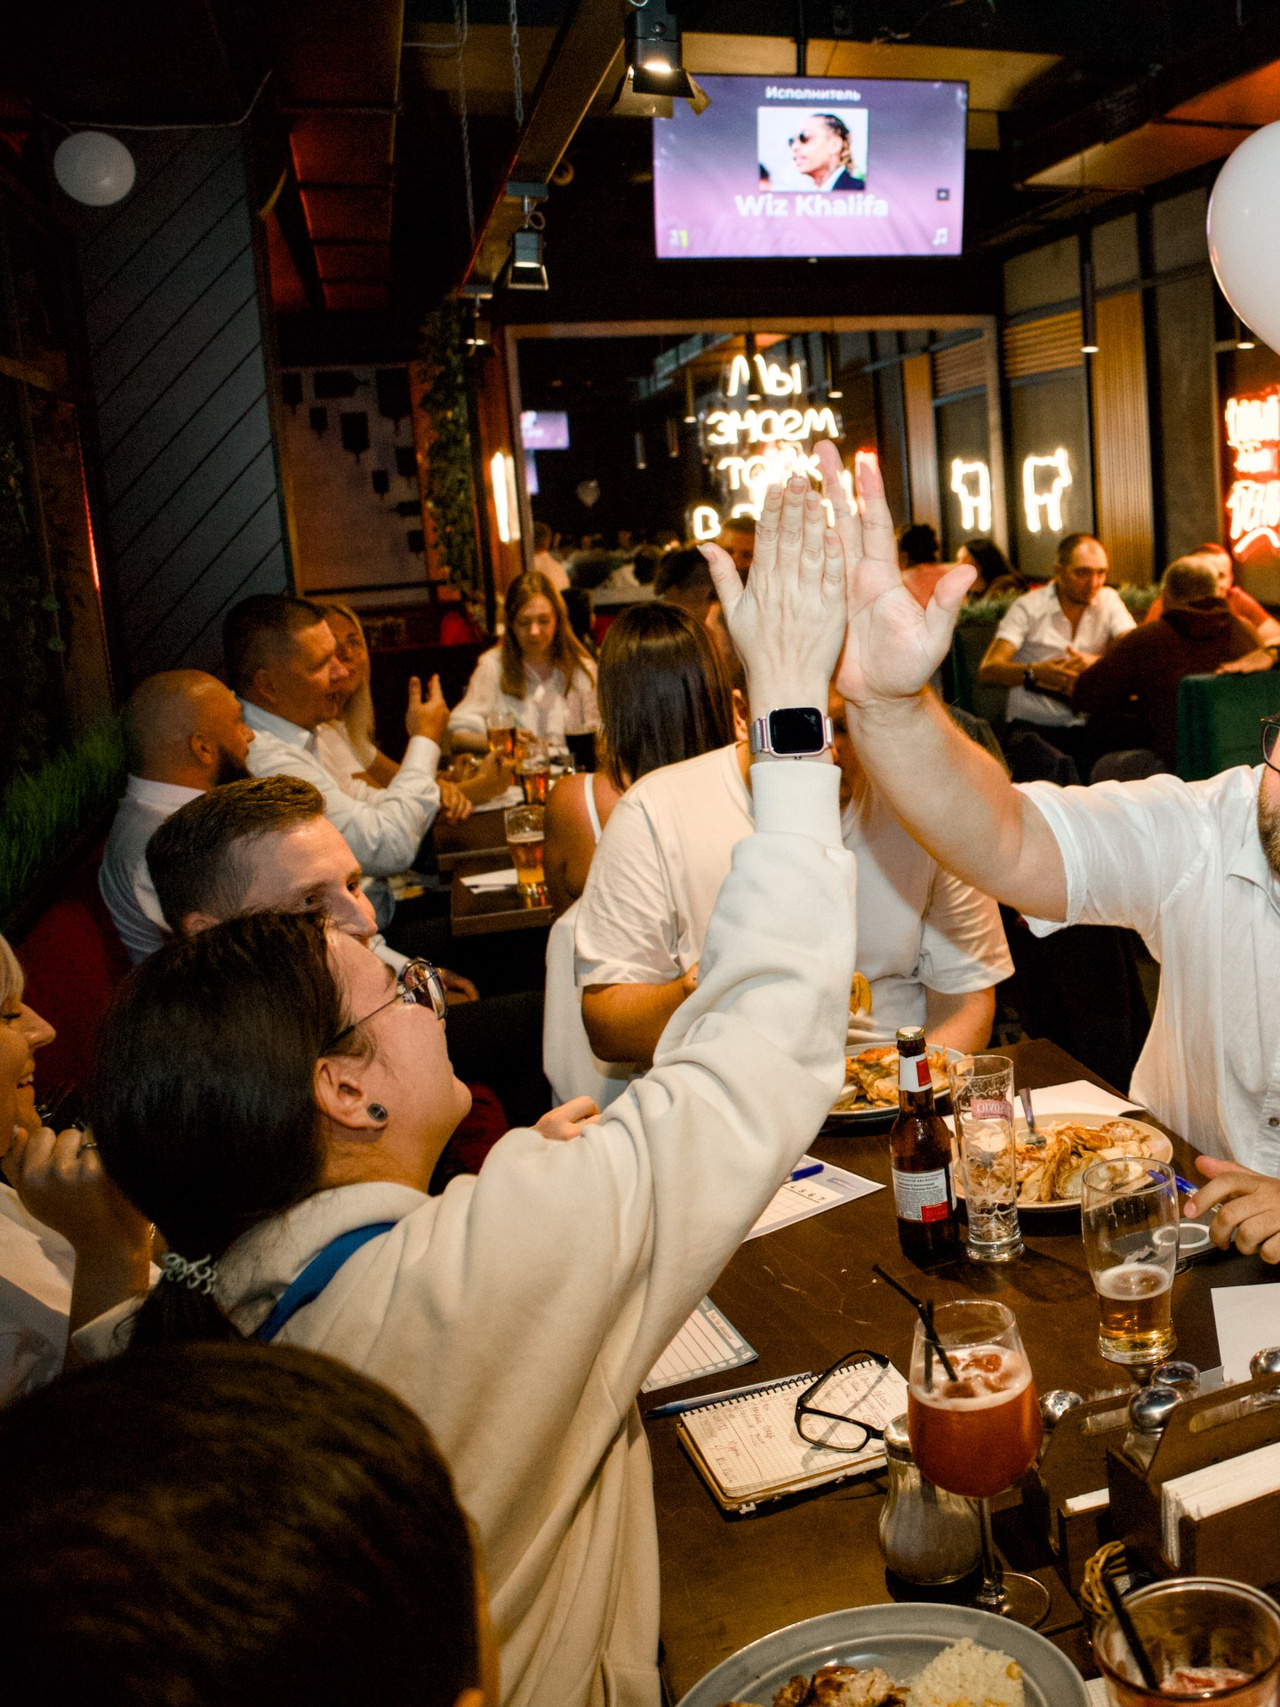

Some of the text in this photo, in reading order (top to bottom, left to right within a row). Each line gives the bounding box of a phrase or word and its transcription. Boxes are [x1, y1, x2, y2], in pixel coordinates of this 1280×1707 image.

[765, 86, 861, 102] Исполнитель
[735, 194, 888, 217] Wiz Khalifa
